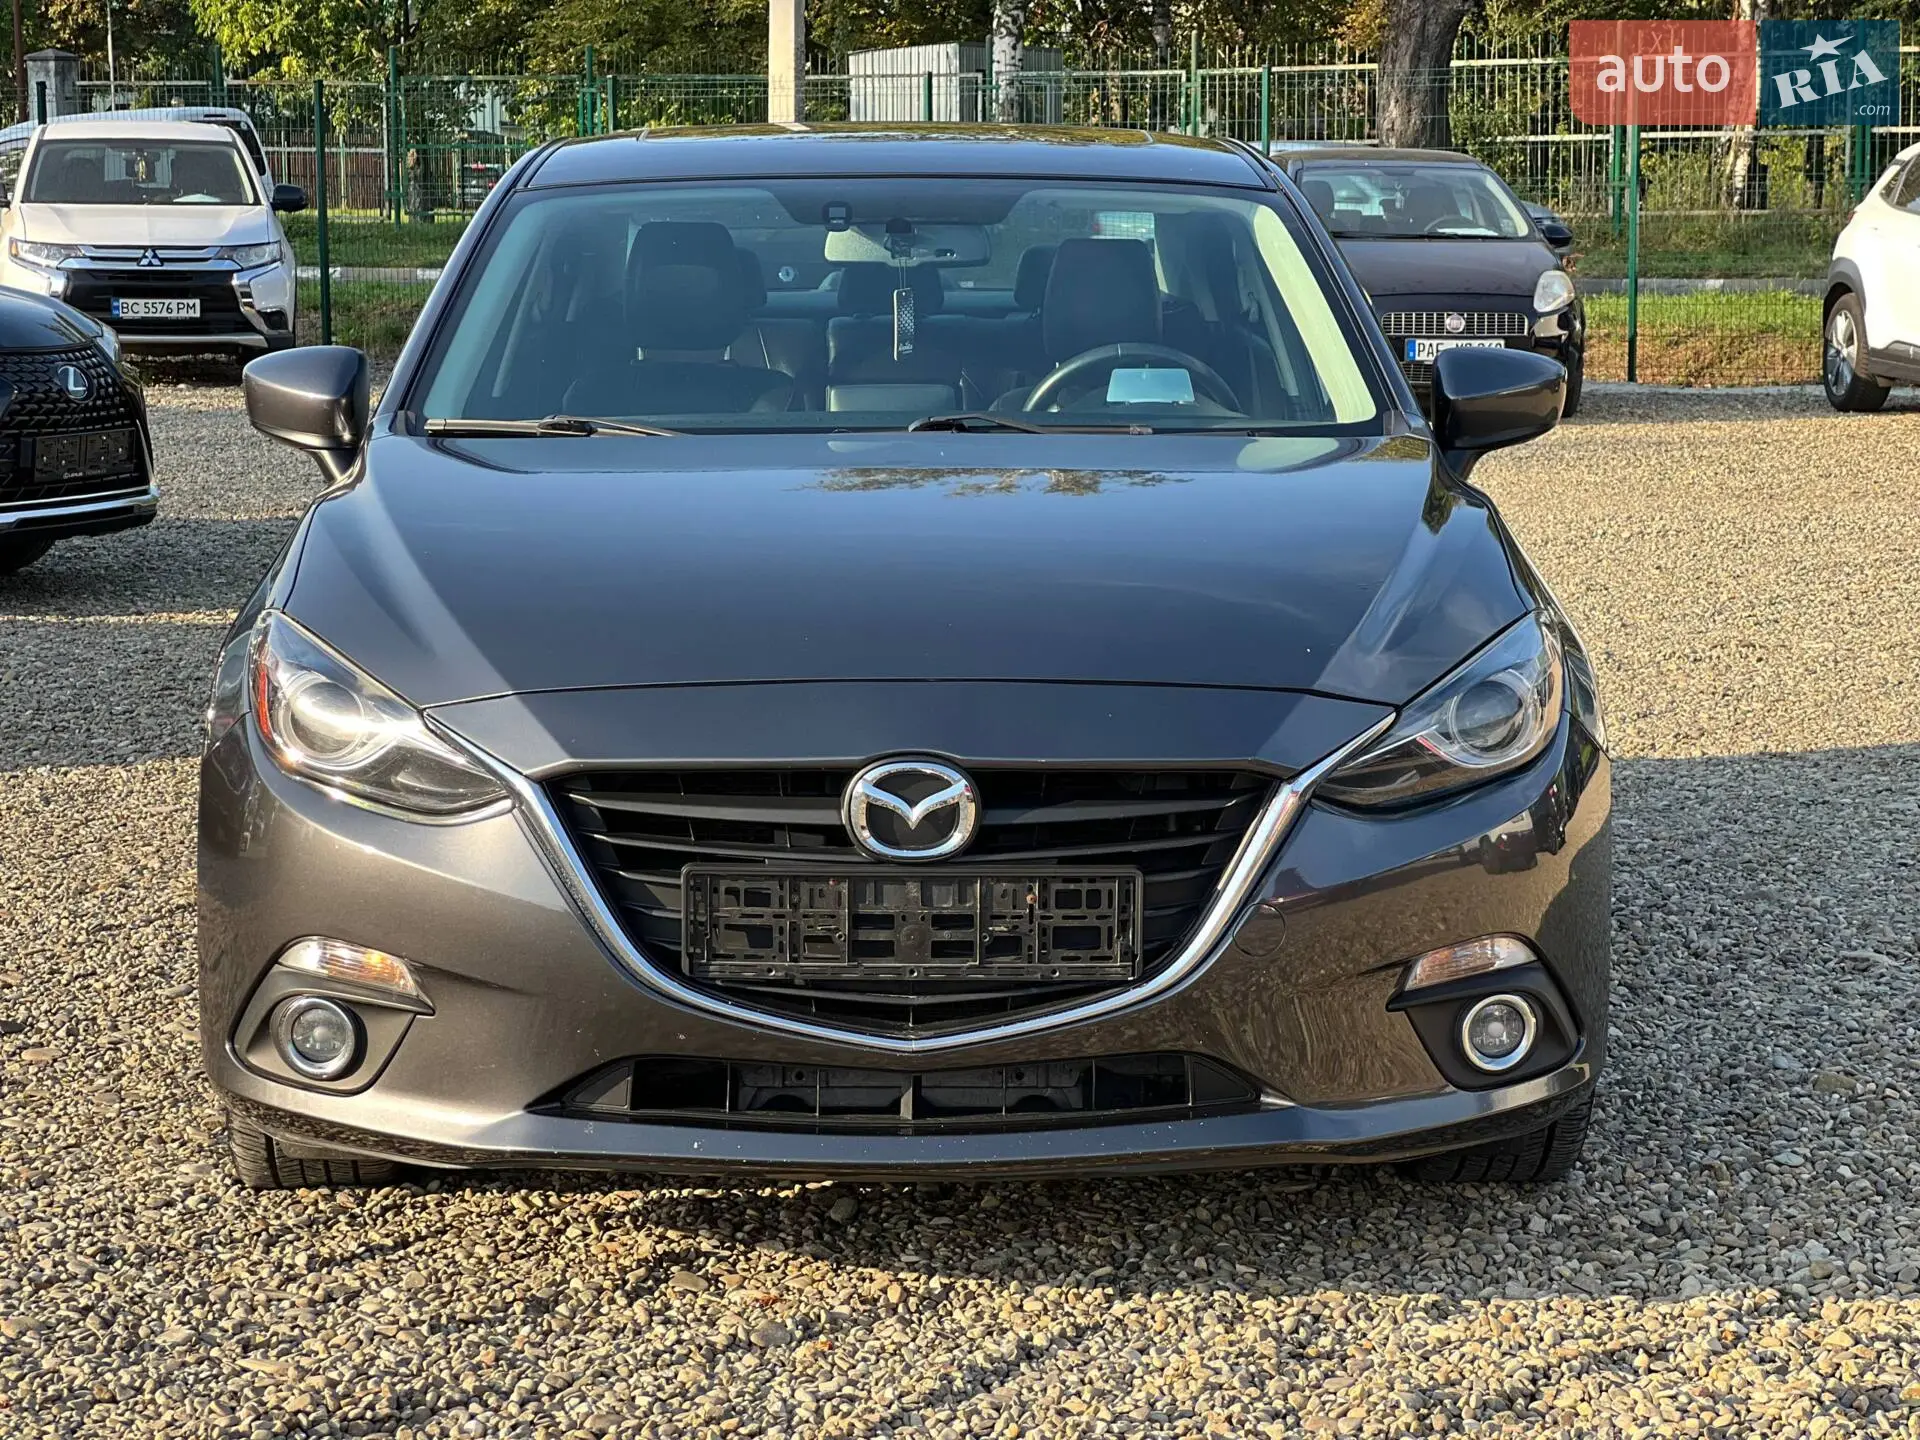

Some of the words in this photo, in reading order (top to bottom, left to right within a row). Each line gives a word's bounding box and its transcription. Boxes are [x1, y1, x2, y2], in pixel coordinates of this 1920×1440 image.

[121, 302, 140, 314] BC
[143, 302, 173, 314] 5576
[176, 302, 197, 314] PM
